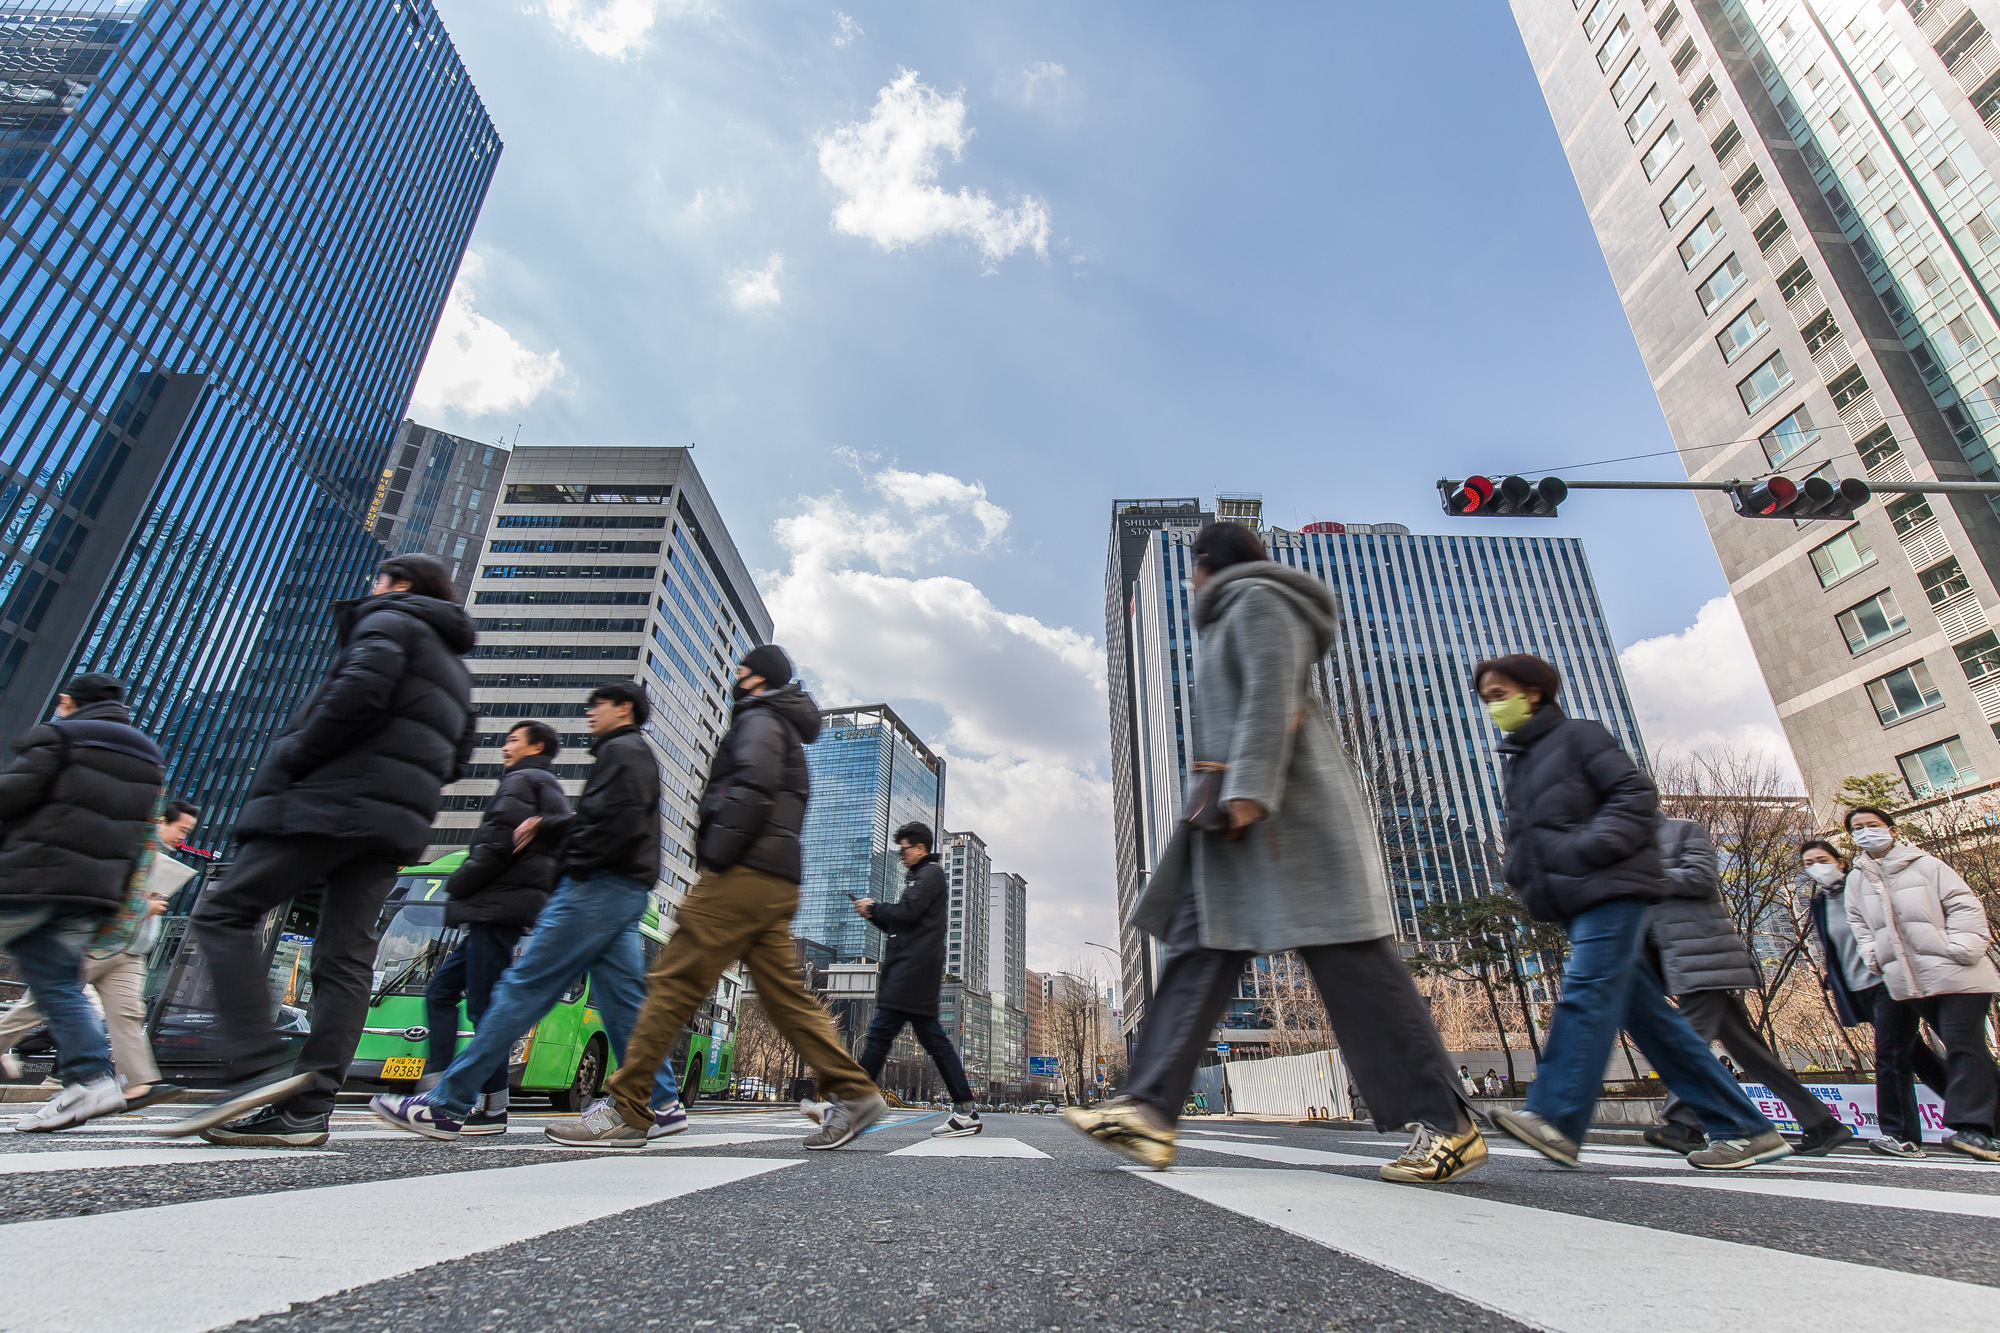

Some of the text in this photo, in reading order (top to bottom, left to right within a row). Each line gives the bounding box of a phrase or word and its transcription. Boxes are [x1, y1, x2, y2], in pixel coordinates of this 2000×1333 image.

[1124, 519, 1161, 527] SHILLA
[1256, 532, 1304, 549] WER
[291, 911, 300, 924] 역
[1806, 1087, 1843, 1101] 덕역점
